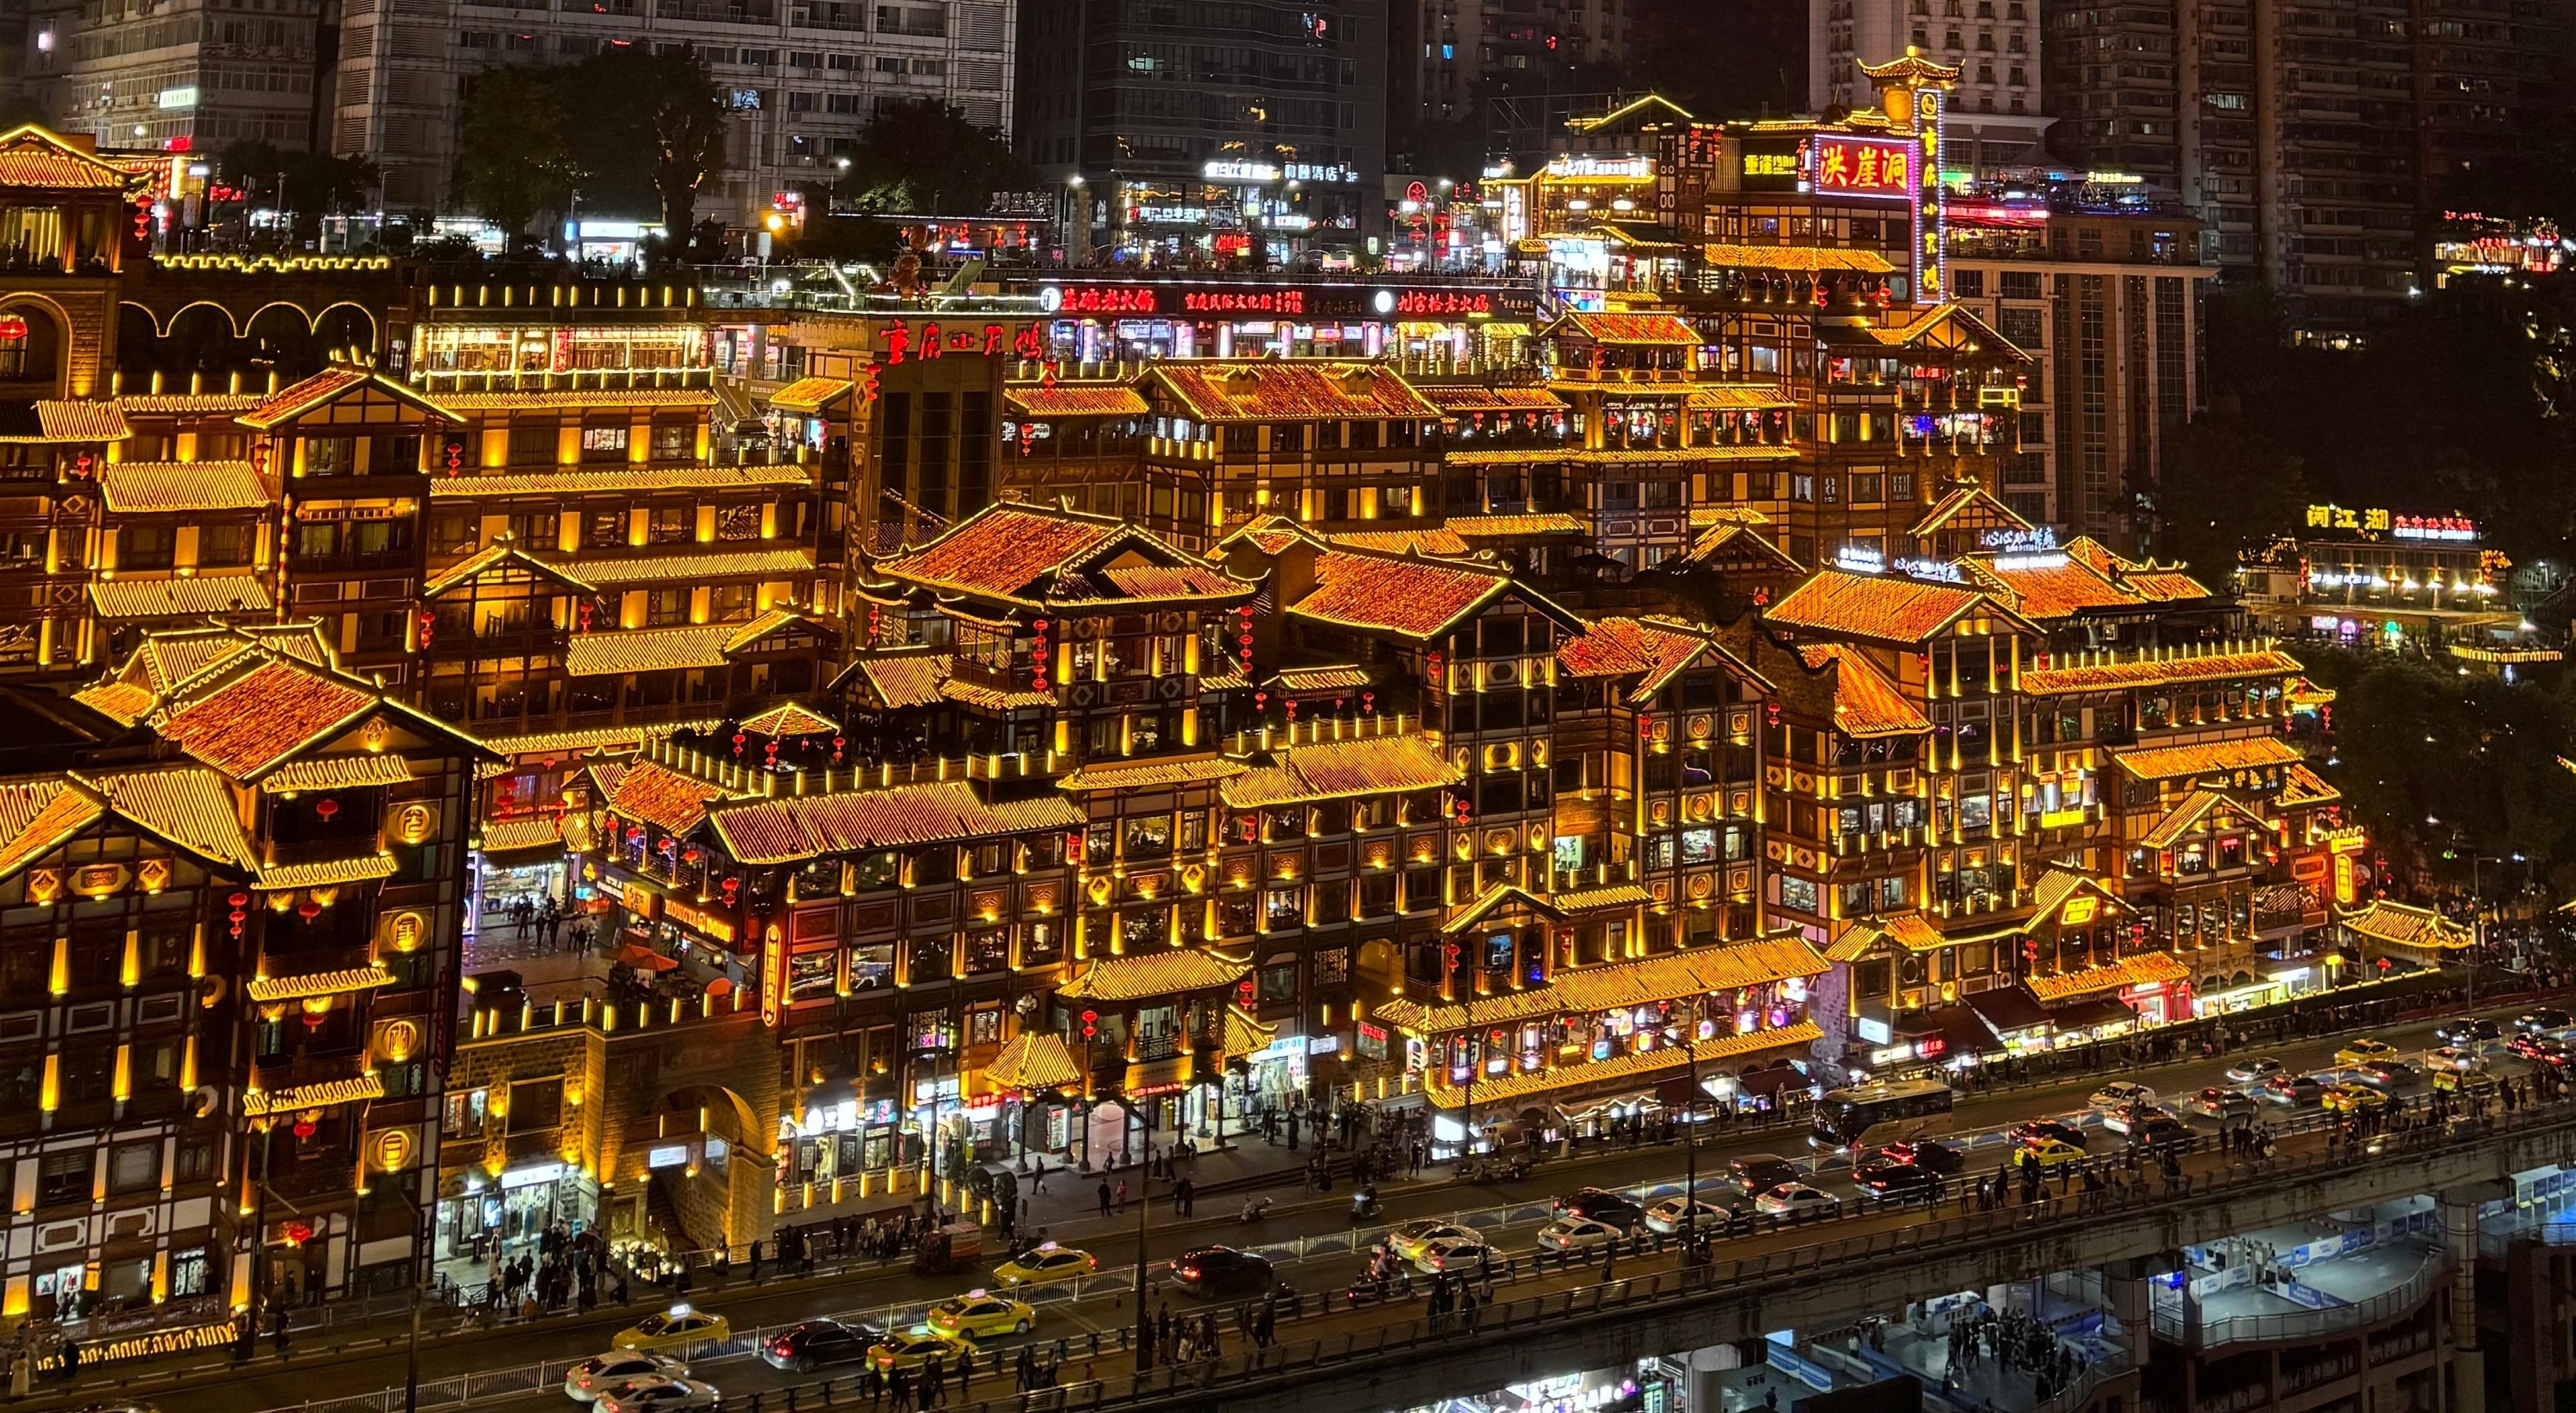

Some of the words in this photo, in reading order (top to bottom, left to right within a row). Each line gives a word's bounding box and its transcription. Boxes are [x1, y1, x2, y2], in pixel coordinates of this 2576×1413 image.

[1820, 145, 1907, 190] 洪崖洞
[665, 899, 698, 928] HONGYA
[706, 917, 731, 943] DONG
